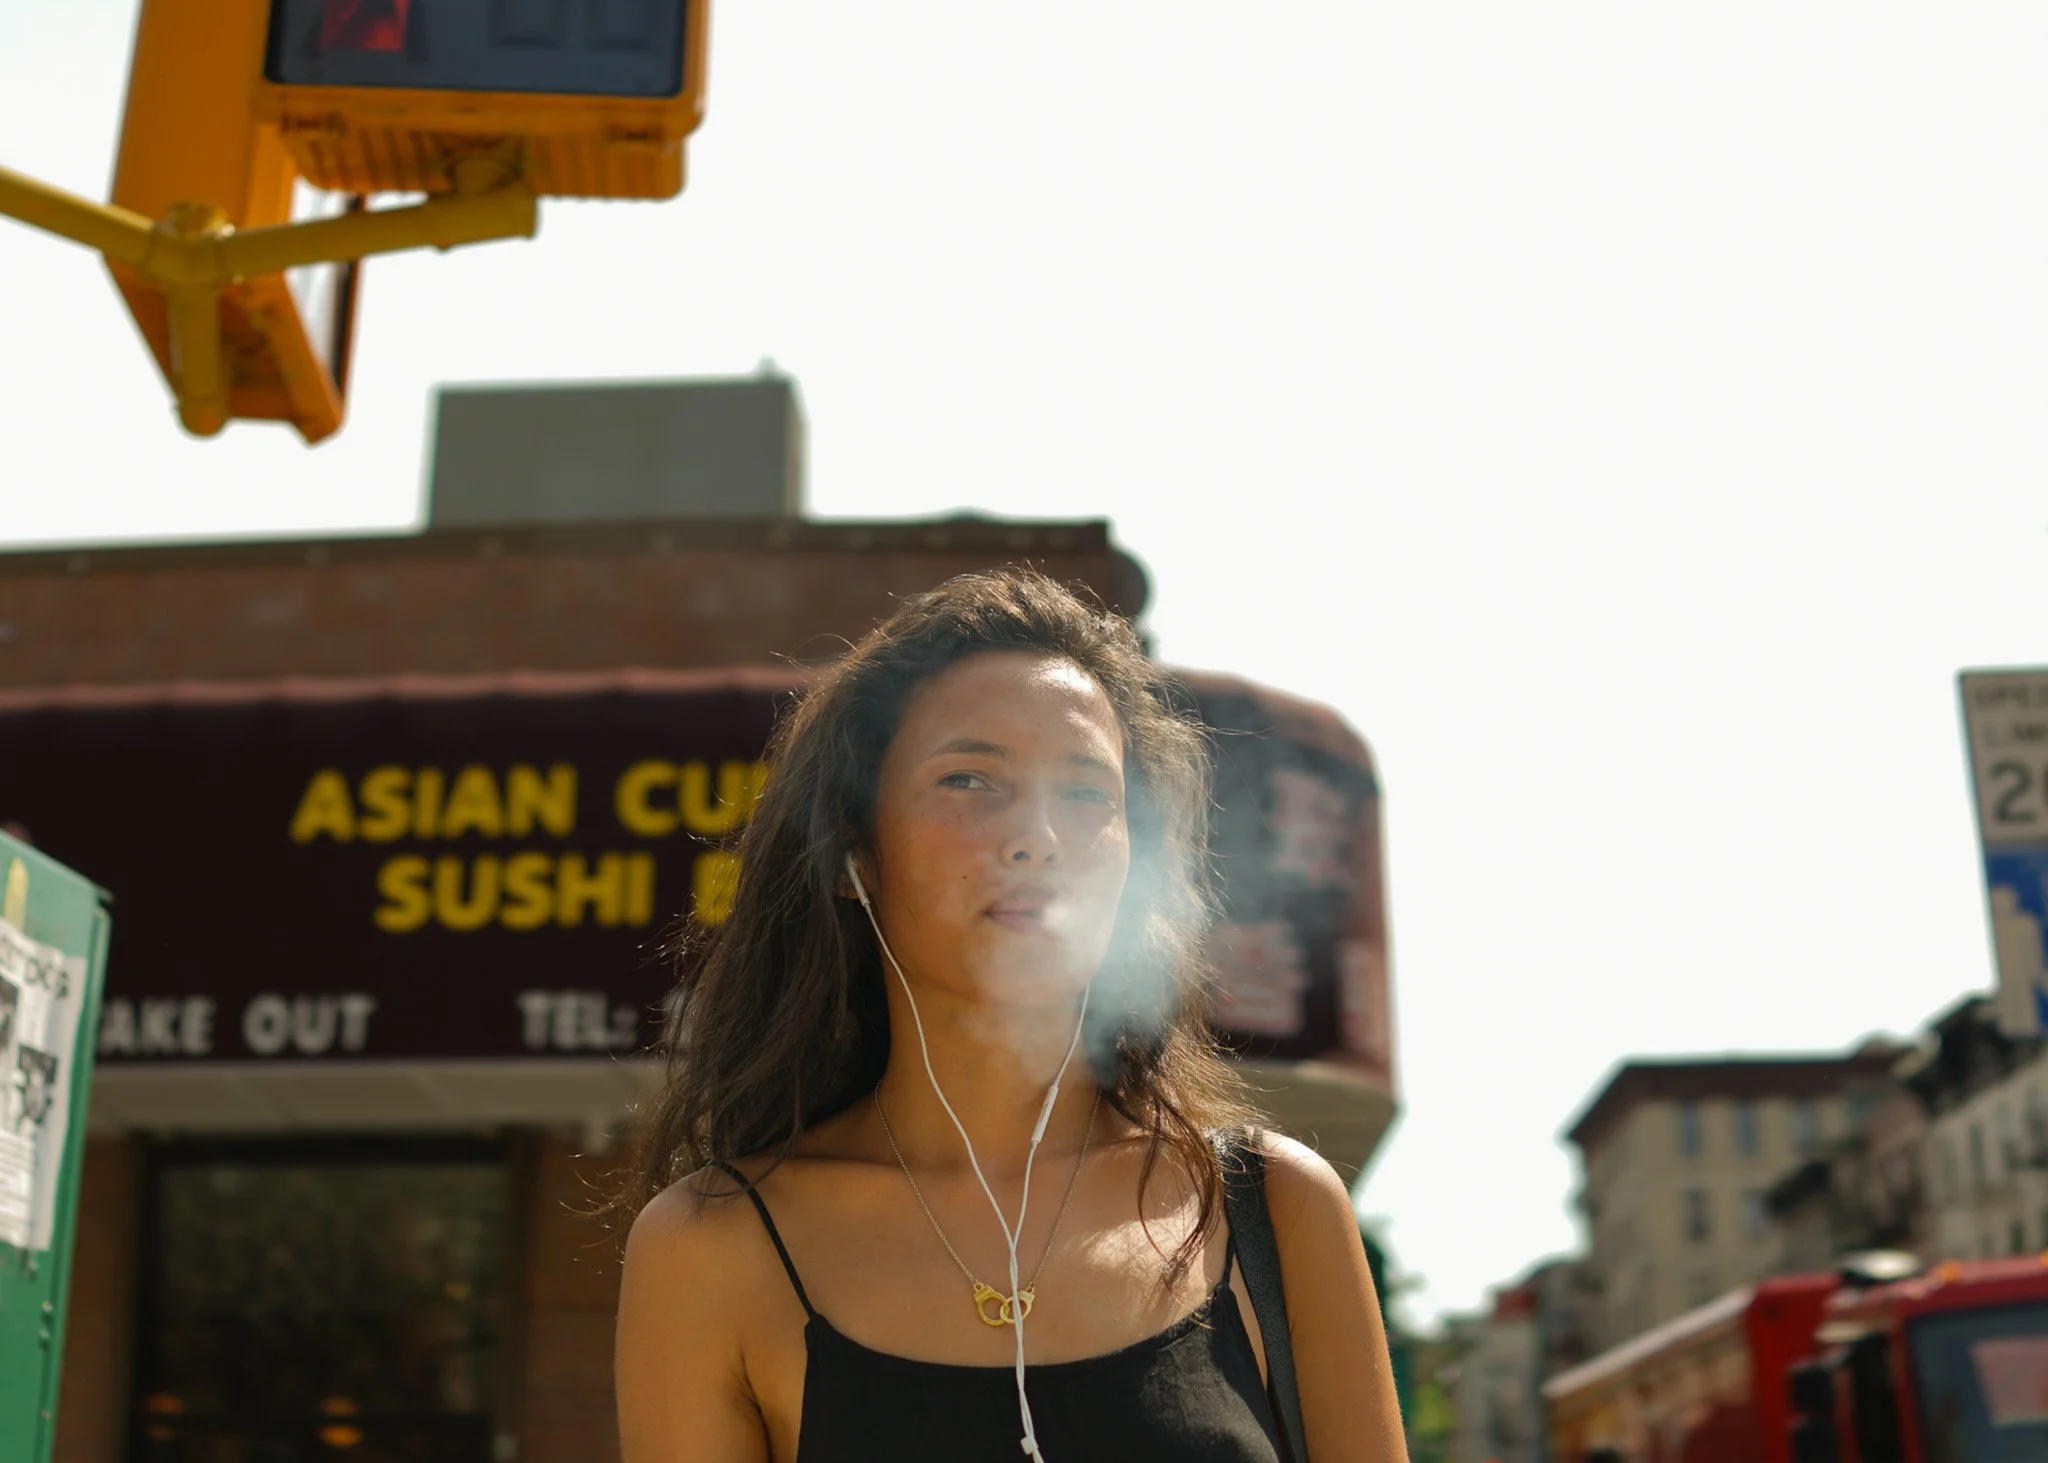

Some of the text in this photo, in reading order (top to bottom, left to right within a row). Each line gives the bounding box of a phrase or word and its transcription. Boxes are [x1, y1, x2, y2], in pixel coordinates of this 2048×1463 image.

[292, 763, 576, 840] ASIAN
[375, 853, 654, 931] SUSHI
[244, 992, 374, 1053] OUT
[518, 989, 639, 1048] TEL:
